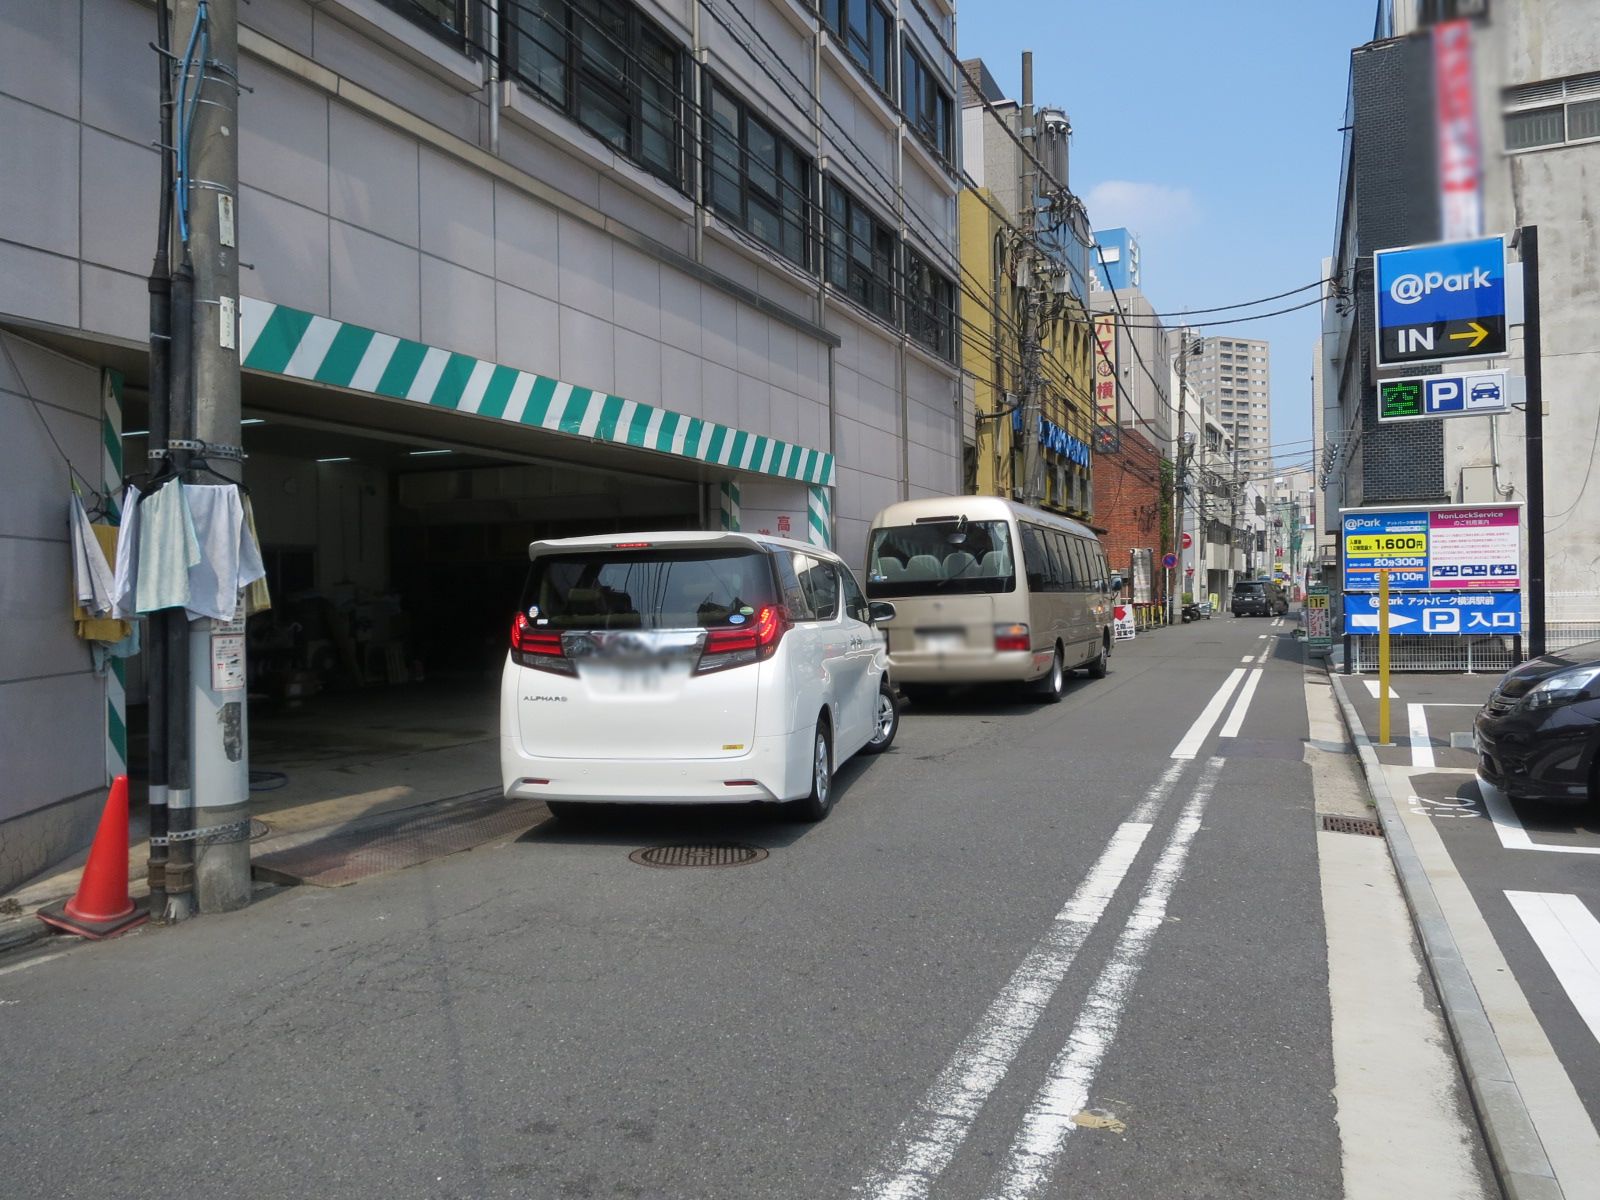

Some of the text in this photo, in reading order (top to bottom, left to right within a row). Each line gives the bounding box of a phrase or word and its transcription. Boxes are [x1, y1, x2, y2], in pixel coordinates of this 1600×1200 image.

[1390, 266, 1492, 305] @Park
[1398, 327, 1434, 353] IN
[1431, 382, 1459, 409] P
[1345, 519, 1381, 530] @Park
[1374, 573, 1424, 581] 6分100円
[1369, 597, 1403, 607] @ark
[1408, 597, 1494, 606] アットパーク横浜駅前
[1429, 611, 1455, 630] P
[1467, 612, 1515, 627] 入口
